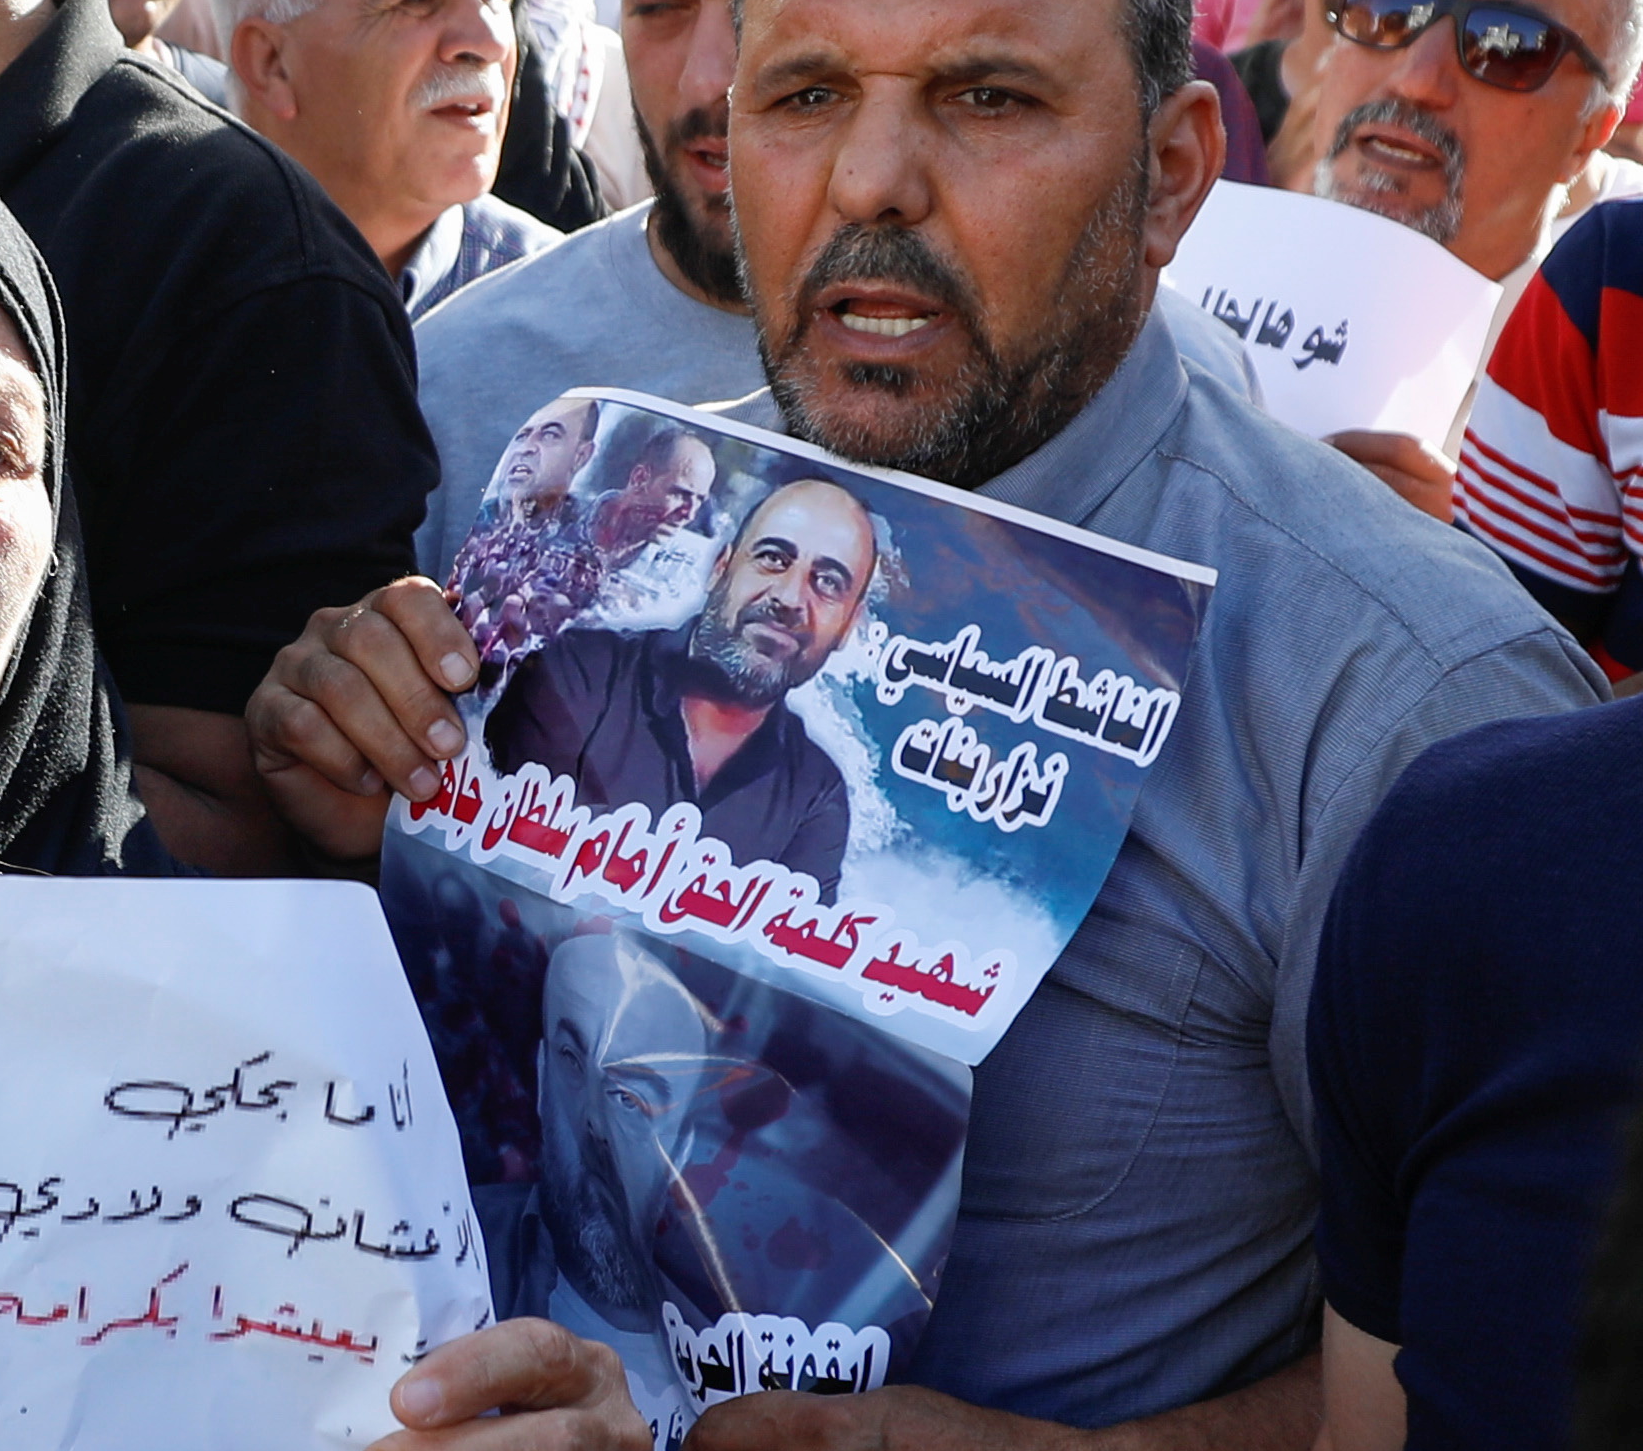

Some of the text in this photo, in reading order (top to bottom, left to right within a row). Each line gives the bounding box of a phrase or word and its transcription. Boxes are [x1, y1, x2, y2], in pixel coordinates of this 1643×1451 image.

[1292, 318, 1349, 371] شو
[1039, 658, 1173, 762] الناشط
[899, 720, 1064, 823] نزار بنات
[480, 778, 576, 860] سلطان
[563, 817, 685, 900] أمام
[659, 853, 774, 933] الحق
[762, 887, 879, 970] كلمة
[861, 942, 1002, 1018] شهيد
